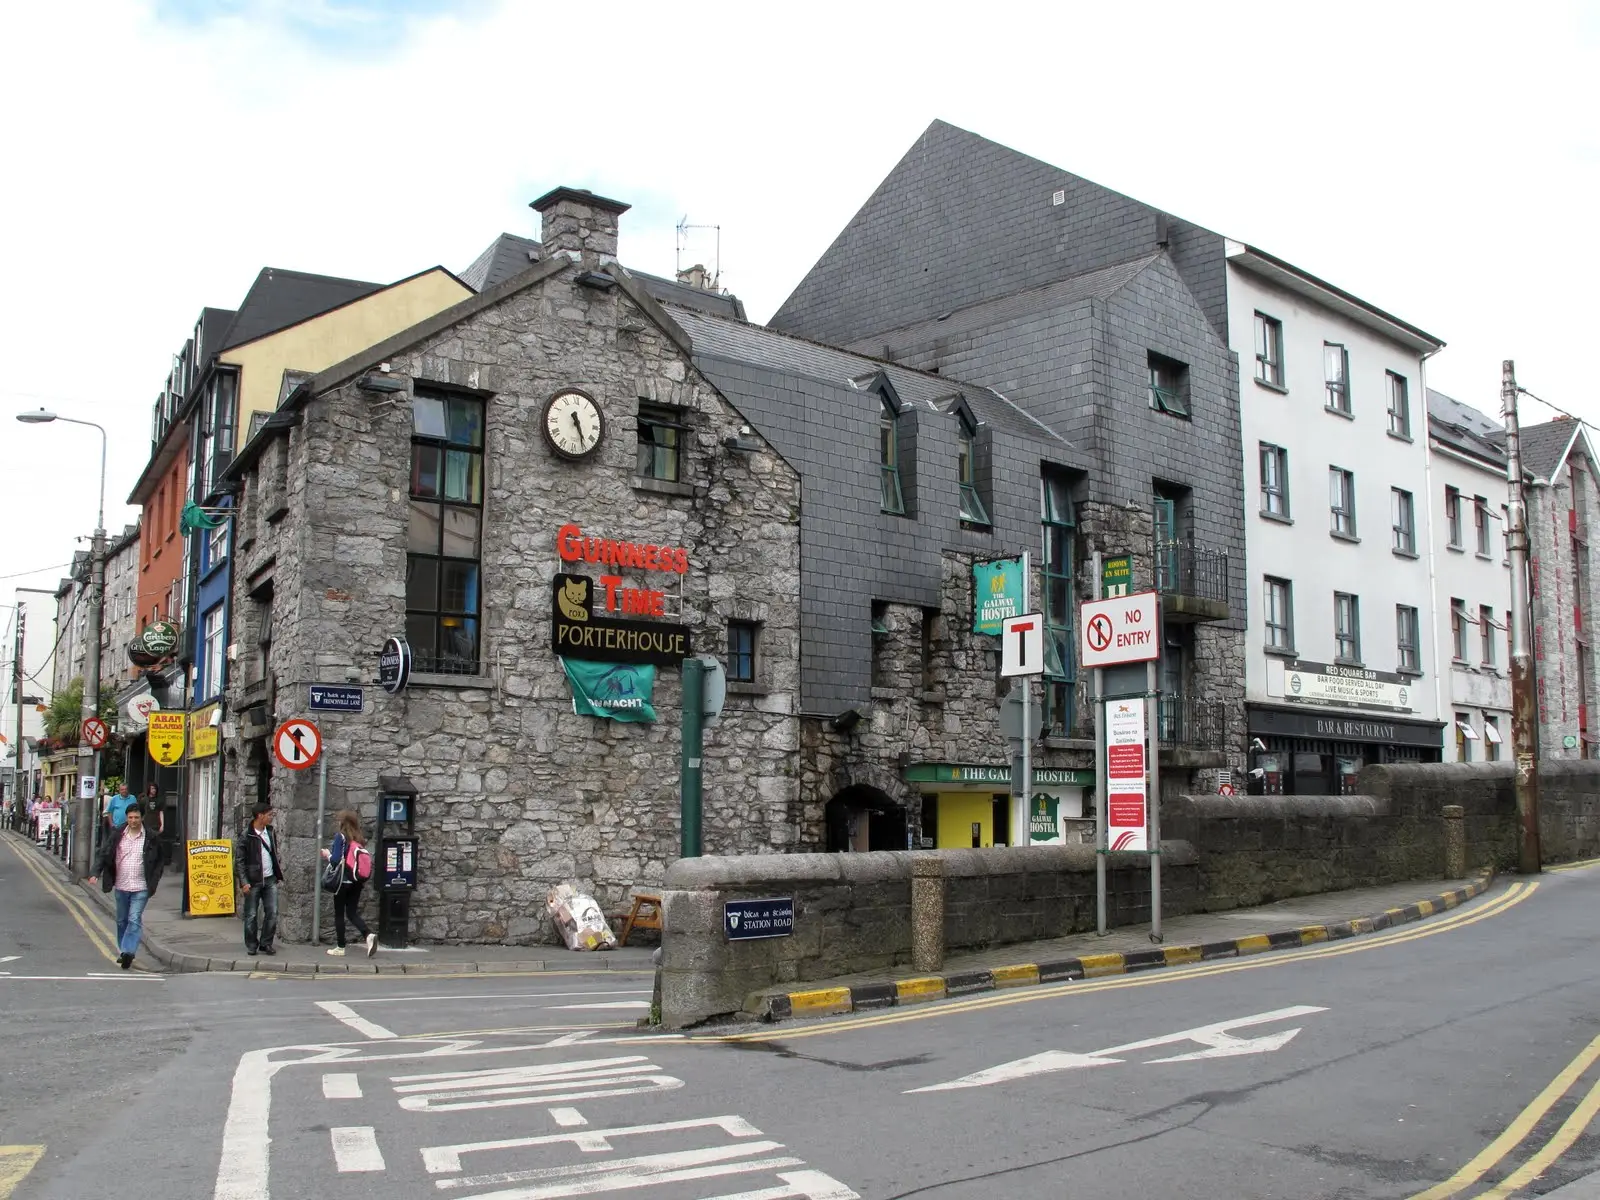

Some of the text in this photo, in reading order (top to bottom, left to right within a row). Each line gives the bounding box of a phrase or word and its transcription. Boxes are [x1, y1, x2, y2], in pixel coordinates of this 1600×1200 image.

[557, 523, 689, 574] GUINNESS
[1114, 569, 1129, 577] SUITE
[601, 575, 665, 617] TIME
[984, 597, 1015, 608] GALWAY
[568, 609, 586, 619] FOXS
[981, 605, 1018, 621] HOSTEL
[1125, 609, 1142, 624] NO
[143, 631, 176, 643] Carlsberg
[558, 624, 685, 654] PORTERHOUSE
[1117, 630, 1151, 647] ENTRY
[381, 655, 400, 667] GUINNESS
[1325, 665, 1377, 680] RED SQUARE BAR
[1317, 674, 1329, 683] BAR
[1329, 676, 1345, 686] FOOD
[1345, 678, 1365, 688] SERVED
[1365, 681, 1375, 689] ALL
[1325, 685, 1336, 693] LIVE
[1337, 686, 1355, 696] MUSIC
[1360, 689, 1379, 698] SPORTS
[154, 715, 182, 723] ARAN
[1317, 720, 1396, 739] BAR & RESTAURANT
[962, 767, 986, 780] THE
[1036, 770, 1078, 782] HOSTEL
[390, 801, 404, 820] P
[1032, 815, 1053, 823] GALWAY
[1030, 822, 1056, 833] HOSTEL
[190, 846, 229, 854] PORTERHOUSE
[743, 918, 792, 930] STATION ROAD
